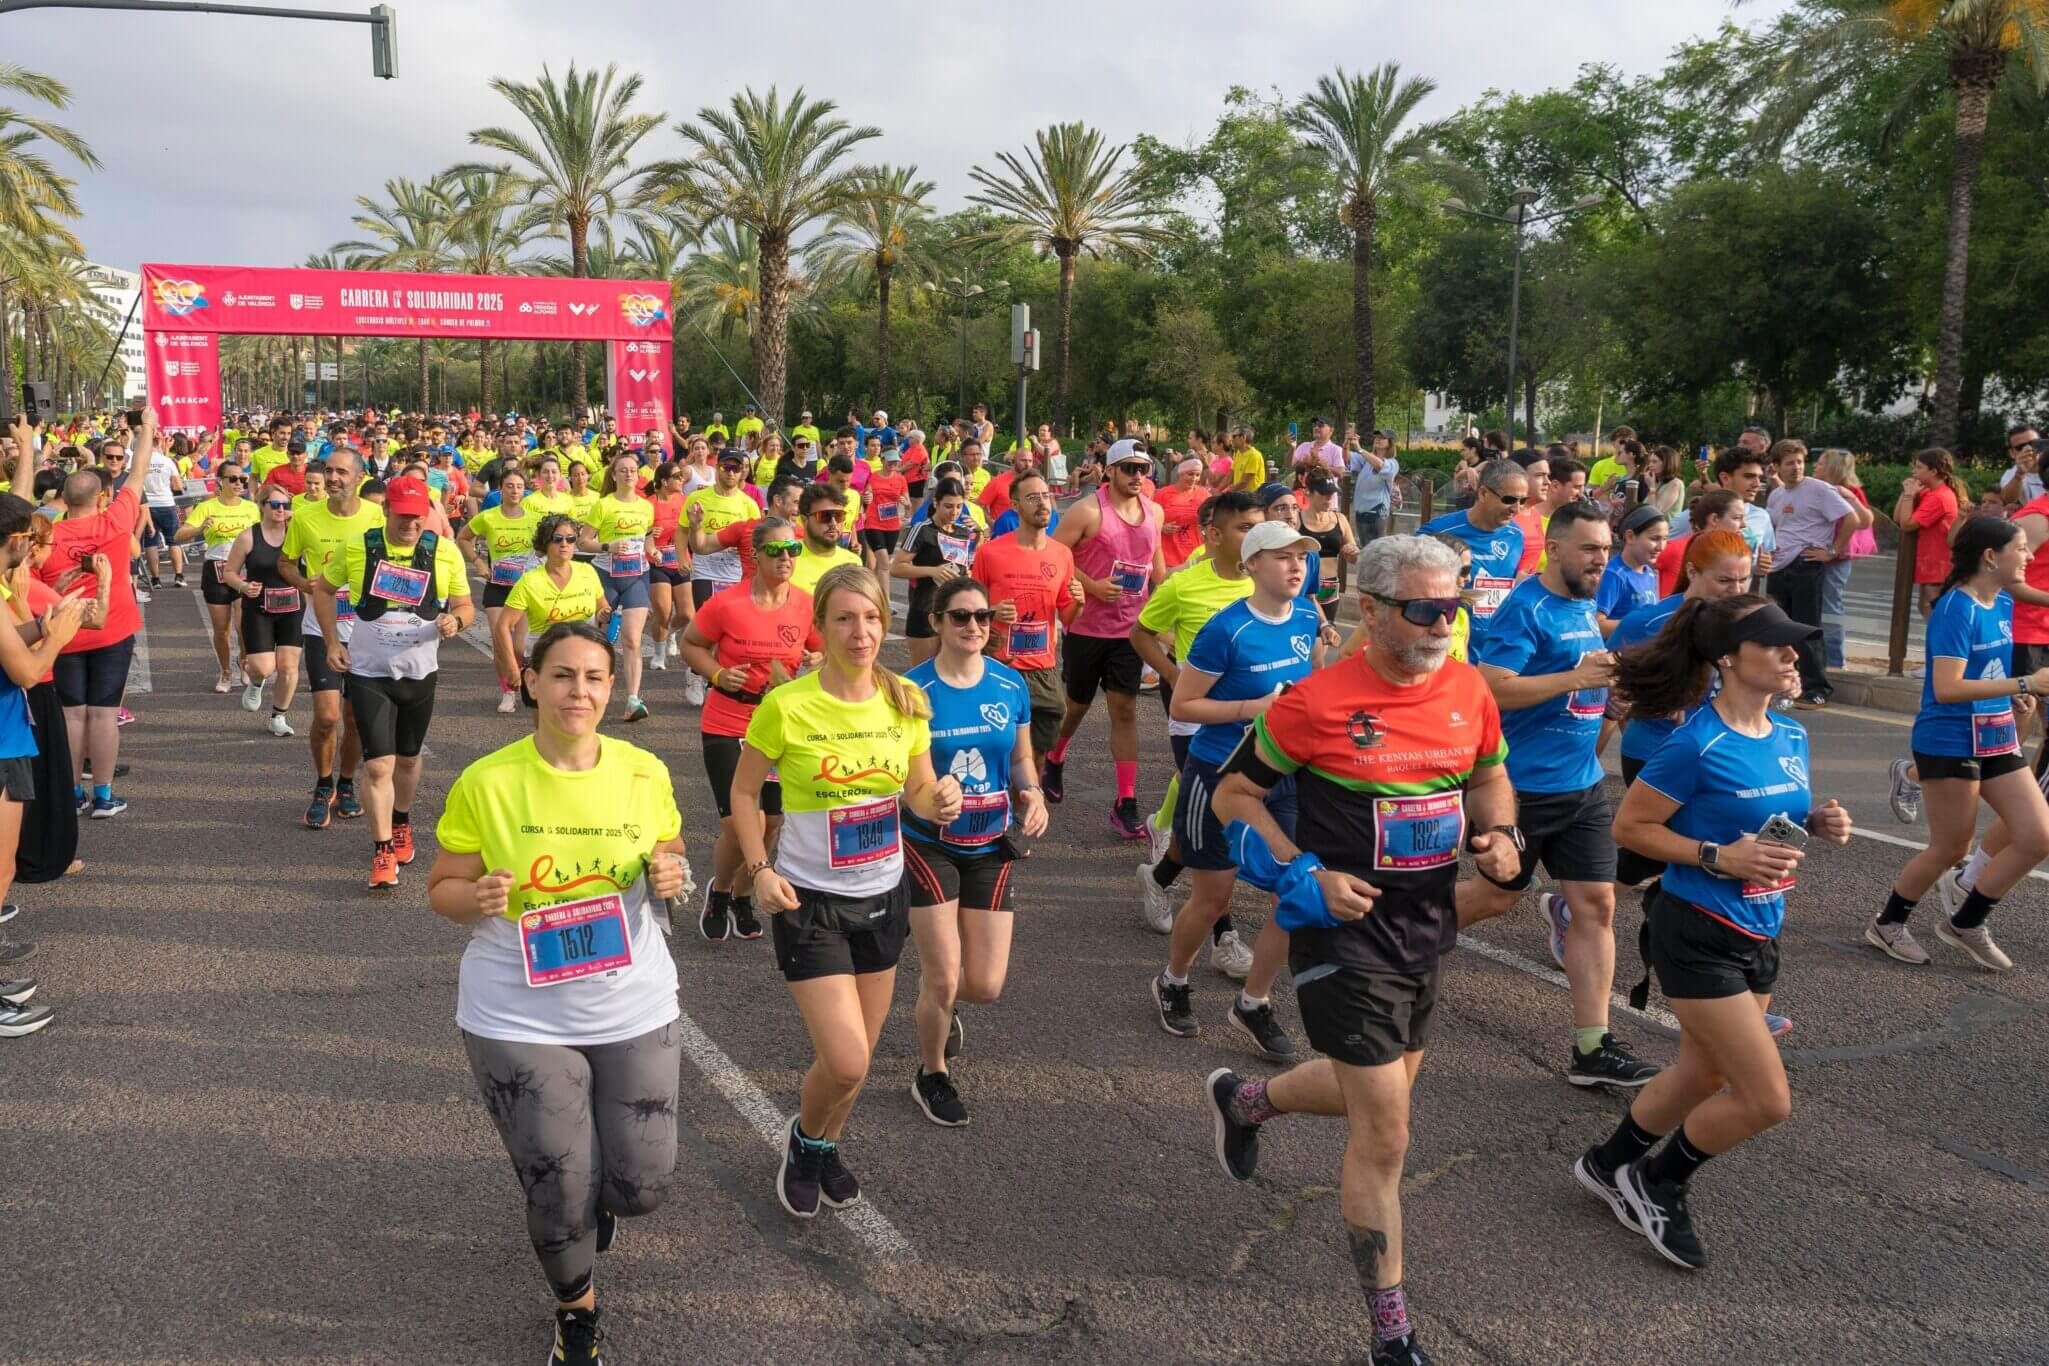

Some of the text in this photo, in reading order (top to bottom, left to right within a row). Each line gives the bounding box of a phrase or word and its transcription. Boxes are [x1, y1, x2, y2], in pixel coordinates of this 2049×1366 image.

[341, 288, 389, 308] CARRERA
[407, 290, 474, 310] SOLIDARIDAD
[477, 292, 504, 311] 2025
[807, 734, 827, 742] CURSA
[1378, 751, 1424, 764] KENYAN
[1424, 747, 1461, 760] URBAN
[521, 825, 622, 837] CURSA SOLIDARITAT 2025
[856, 820, 883, 850] 1349
[1410, 818, 1441, 852] 1322
[558, 924, 597, 961] 1512
